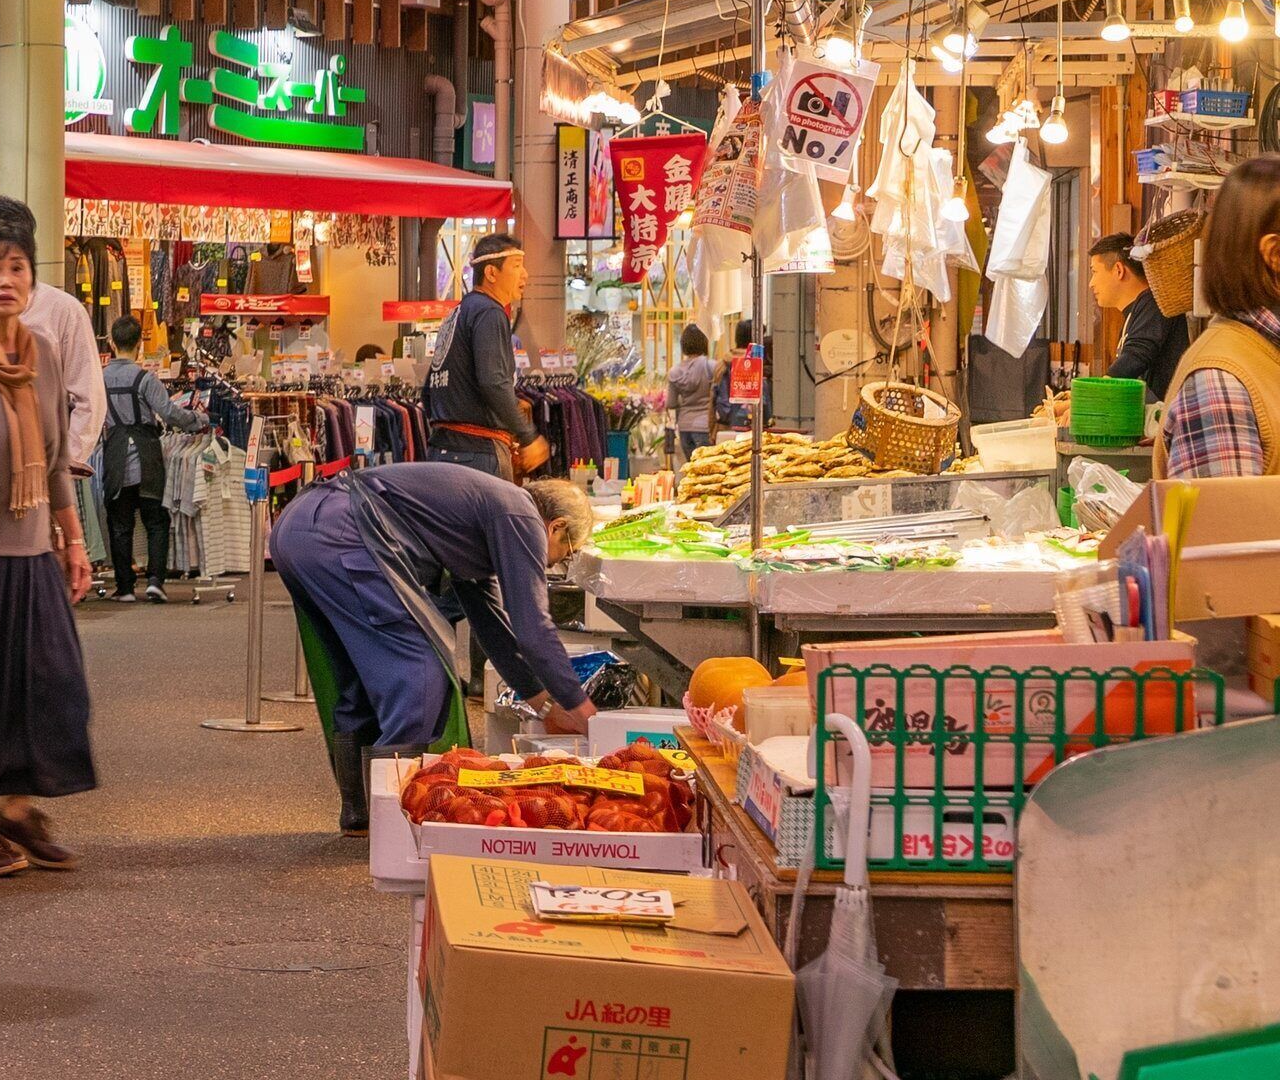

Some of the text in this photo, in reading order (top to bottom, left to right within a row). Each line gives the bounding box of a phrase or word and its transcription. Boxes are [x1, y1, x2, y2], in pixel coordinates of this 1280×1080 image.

[124, 24, 366, 150] オーミスーパー
[563, 150, 580, 220] 清正商店
[628, 184, 659, 274] 大特売
[481, 838, 641, 860] TOMAMAE MELON
[565, 998, 672, 1029] JA紀の里
